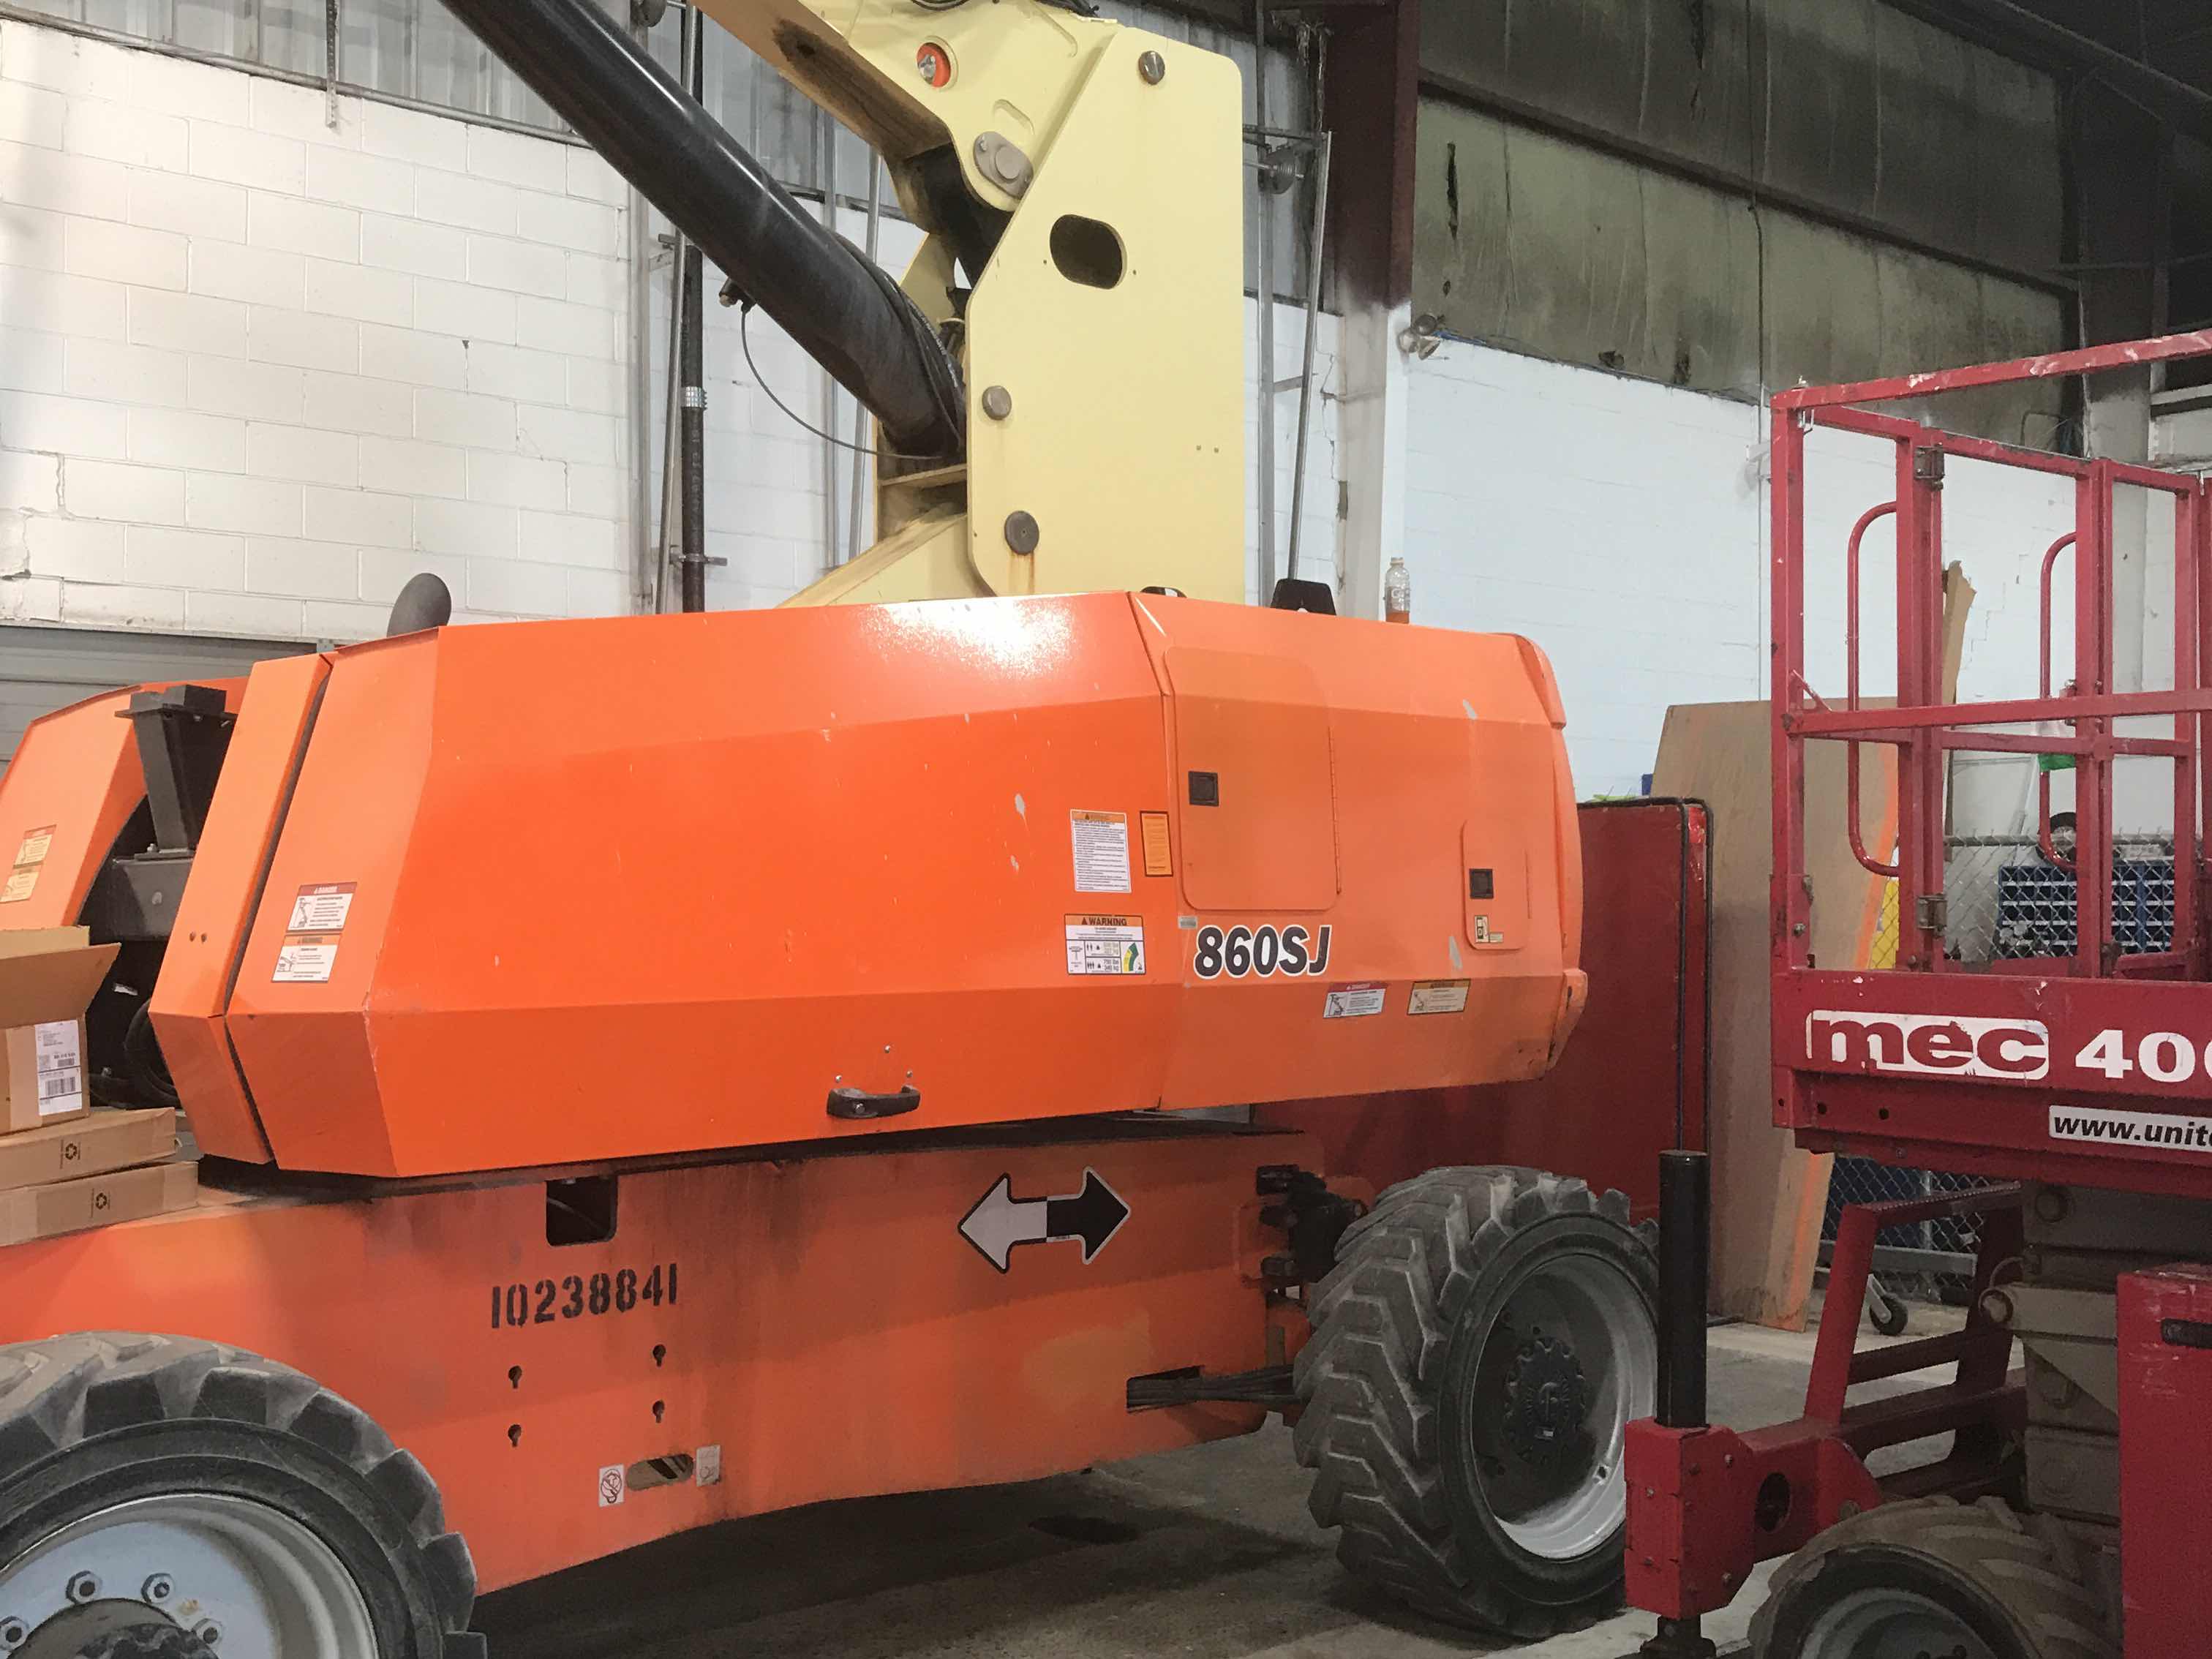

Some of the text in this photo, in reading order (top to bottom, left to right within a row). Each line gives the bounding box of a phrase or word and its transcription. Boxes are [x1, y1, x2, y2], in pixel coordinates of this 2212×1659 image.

[1088, 917, 1127, 926] WARNING
[1193, 925, 1332, 979] 860SJ
[1812, 1020, 2212, 1083] mec 40
[2053, 1116, 2212, 1147] www.unit
[492, 1263, 677, 1329] 10238841
